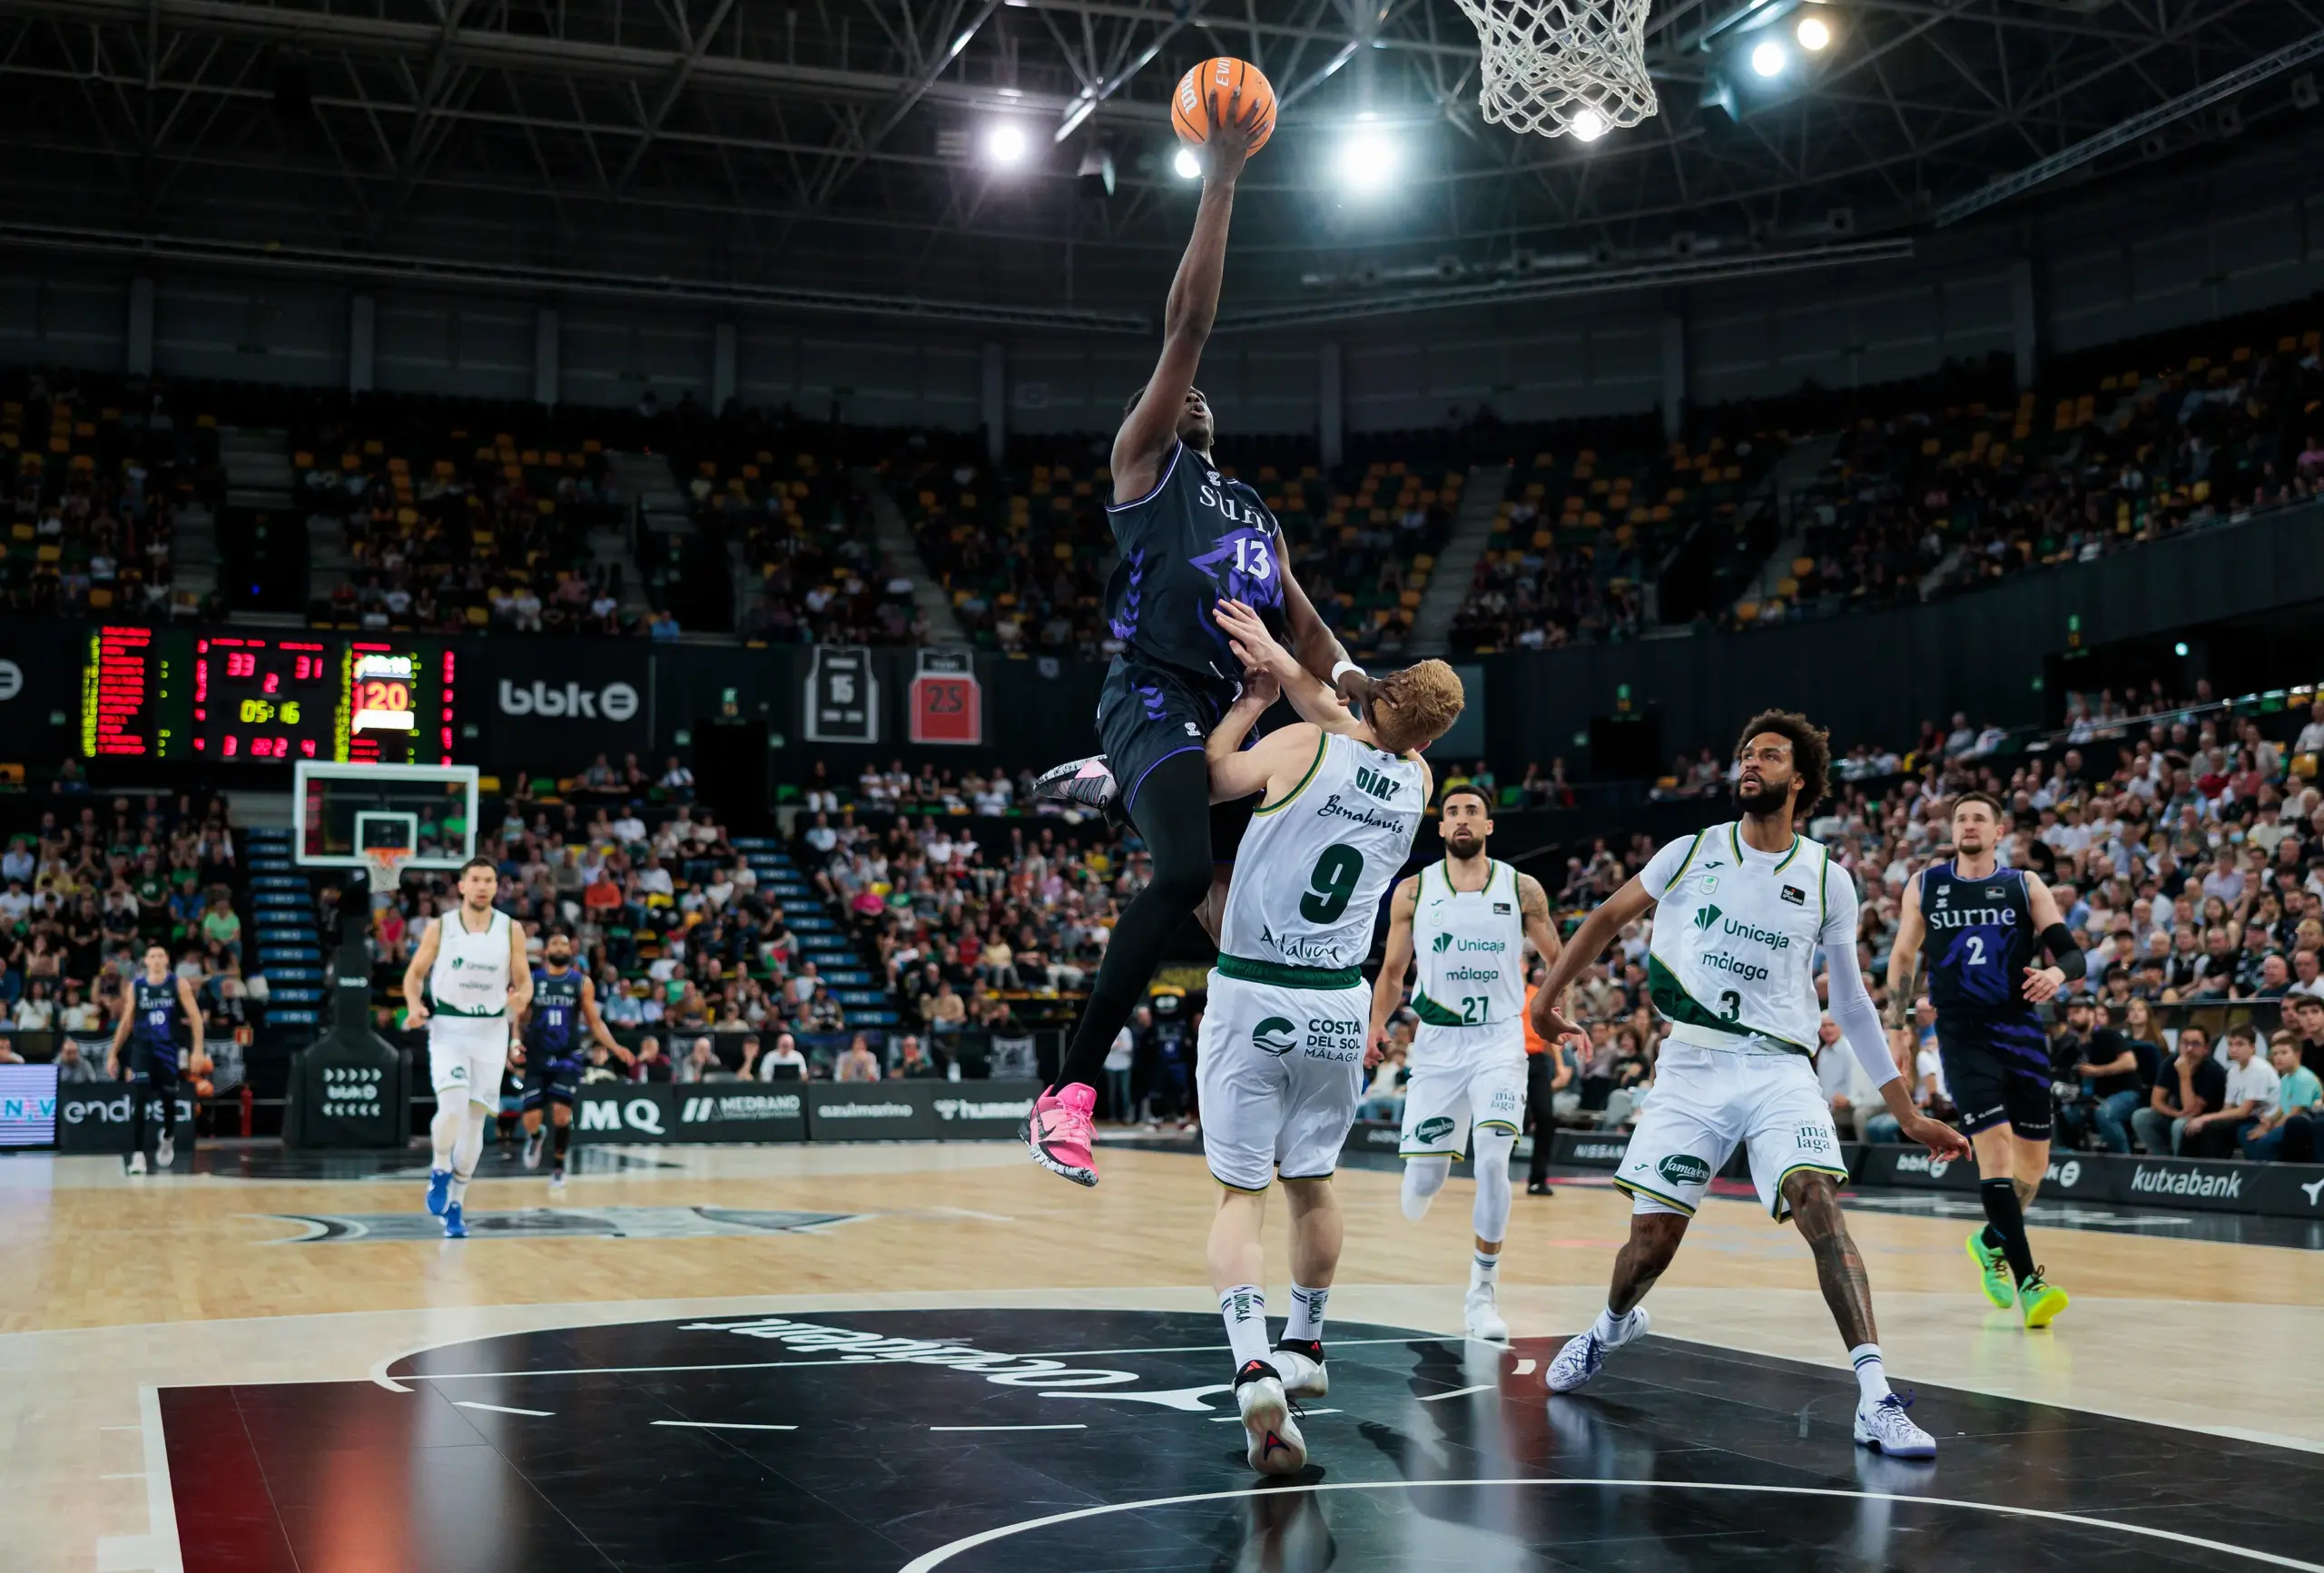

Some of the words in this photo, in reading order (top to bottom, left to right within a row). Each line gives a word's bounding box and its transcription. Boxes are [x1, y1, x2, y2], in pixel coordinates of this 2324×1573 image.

[1234, 537, 1271, 580] 13
[227, 652, 256, 676] 33
[295, 654, 323, 679] 31
[366, 683, 408, 711] 20
[498, 679, 597, 717] bbk
[927, 685, 963, 713] 25
[1355, 765, 1401, 801] DÍAZ
[1299, 844, 1364, 924] 9
[1929, 908, 2016, 930] surne
[1457, 939, 1505, 954] Unicaja
[1725, 918, 1789, 950] Unicaja
[1965, 936, 1987, 965] 2
[149, 1010, 166, 1026] 10
[548, 1009, 562, 1027] 11
[1461, 996, 1490, 1024] 27
[1720, 990, 1740, 1023] 3
[1308, 1018, 1362, 1035] COSTA
[1304, 1047, 1359, 1063] MÁLAGA
[1306, 1035, 1335, 1048] DEL
[1339, 1036, 1361, 1050] SOL
[718, 1095, 801, 1111] MEDRANO
[818, 1101, 913, 1118] azulmarino
[1797, 1136, 1832, 1154] laga
[2131, 1164, 2244, 1199] kutxabank
[1233, 1293, 1250, 1324] UNICAJA
